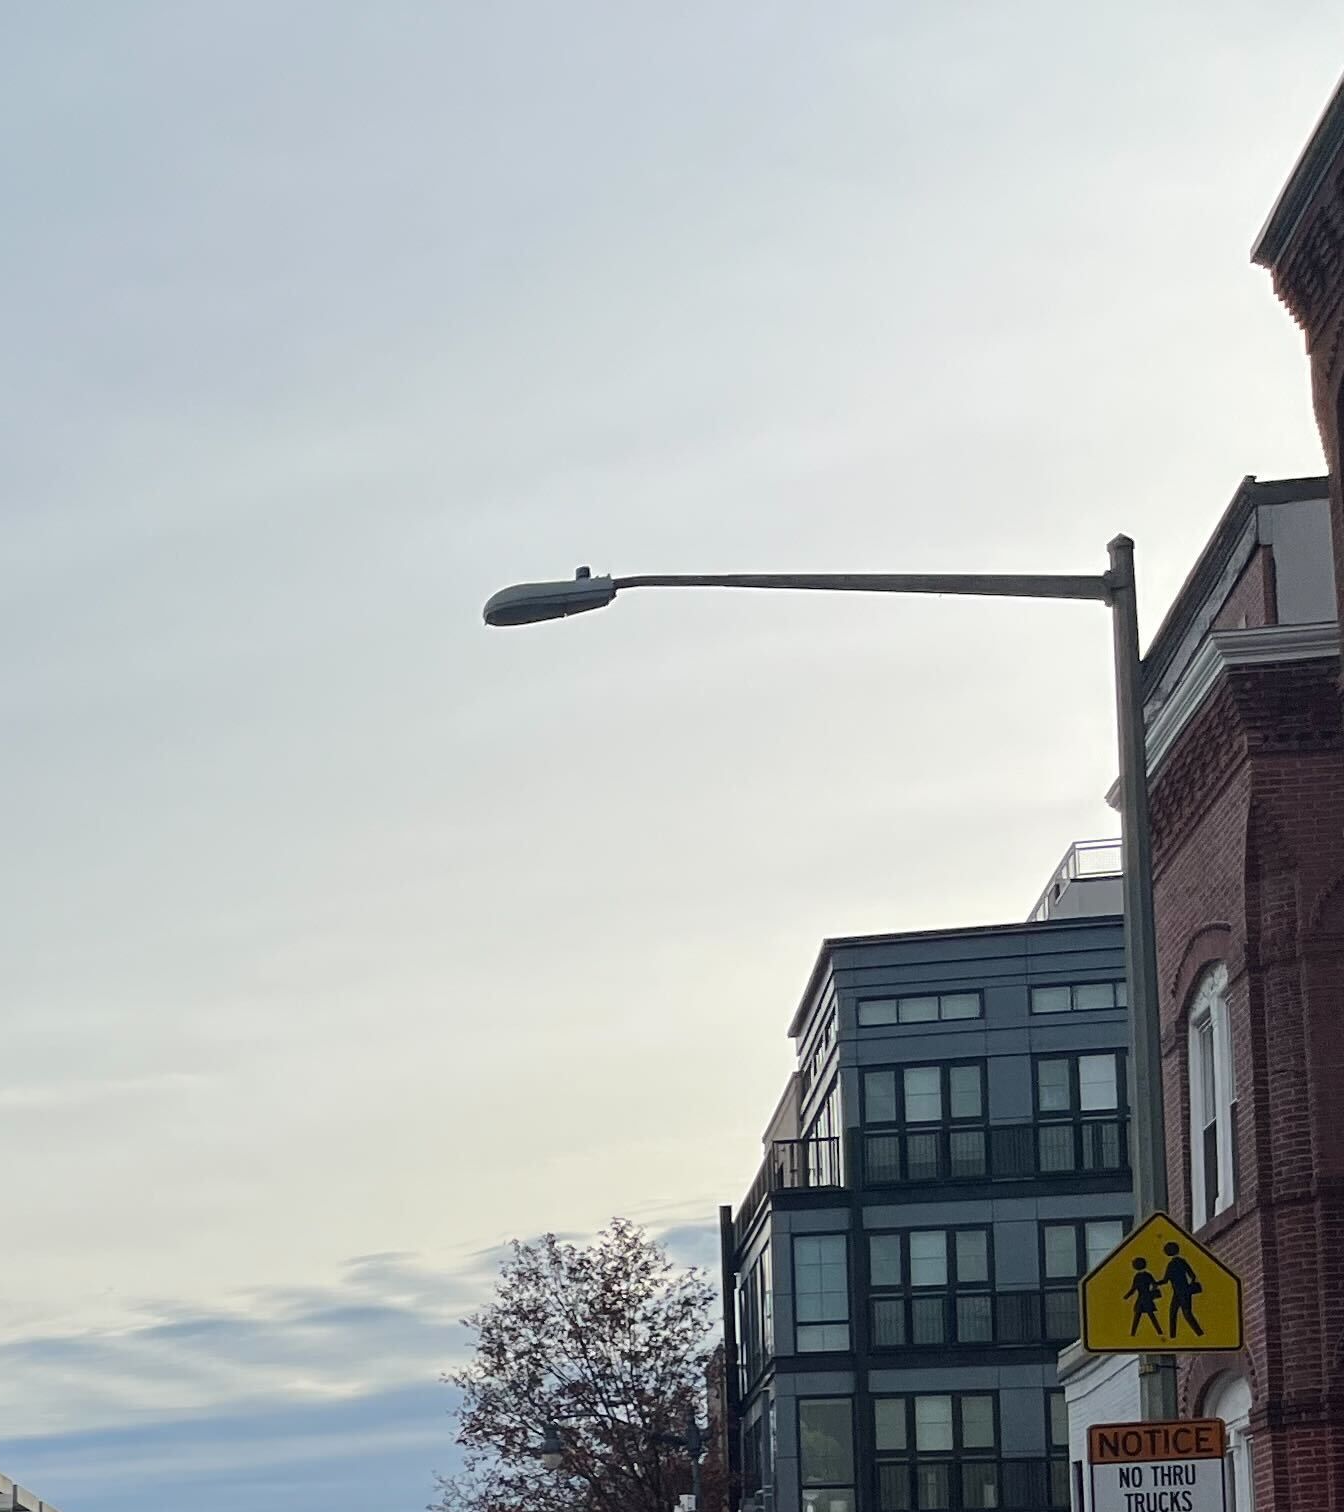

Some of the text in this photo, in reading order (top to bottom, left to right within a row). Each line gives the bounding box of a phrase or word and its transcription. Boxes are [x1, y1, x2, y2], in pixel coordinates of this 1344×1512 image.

[1098, 1427, 1213, 1458] NOTICE
[1119, 1464, 1196, 1488] NO THRU
